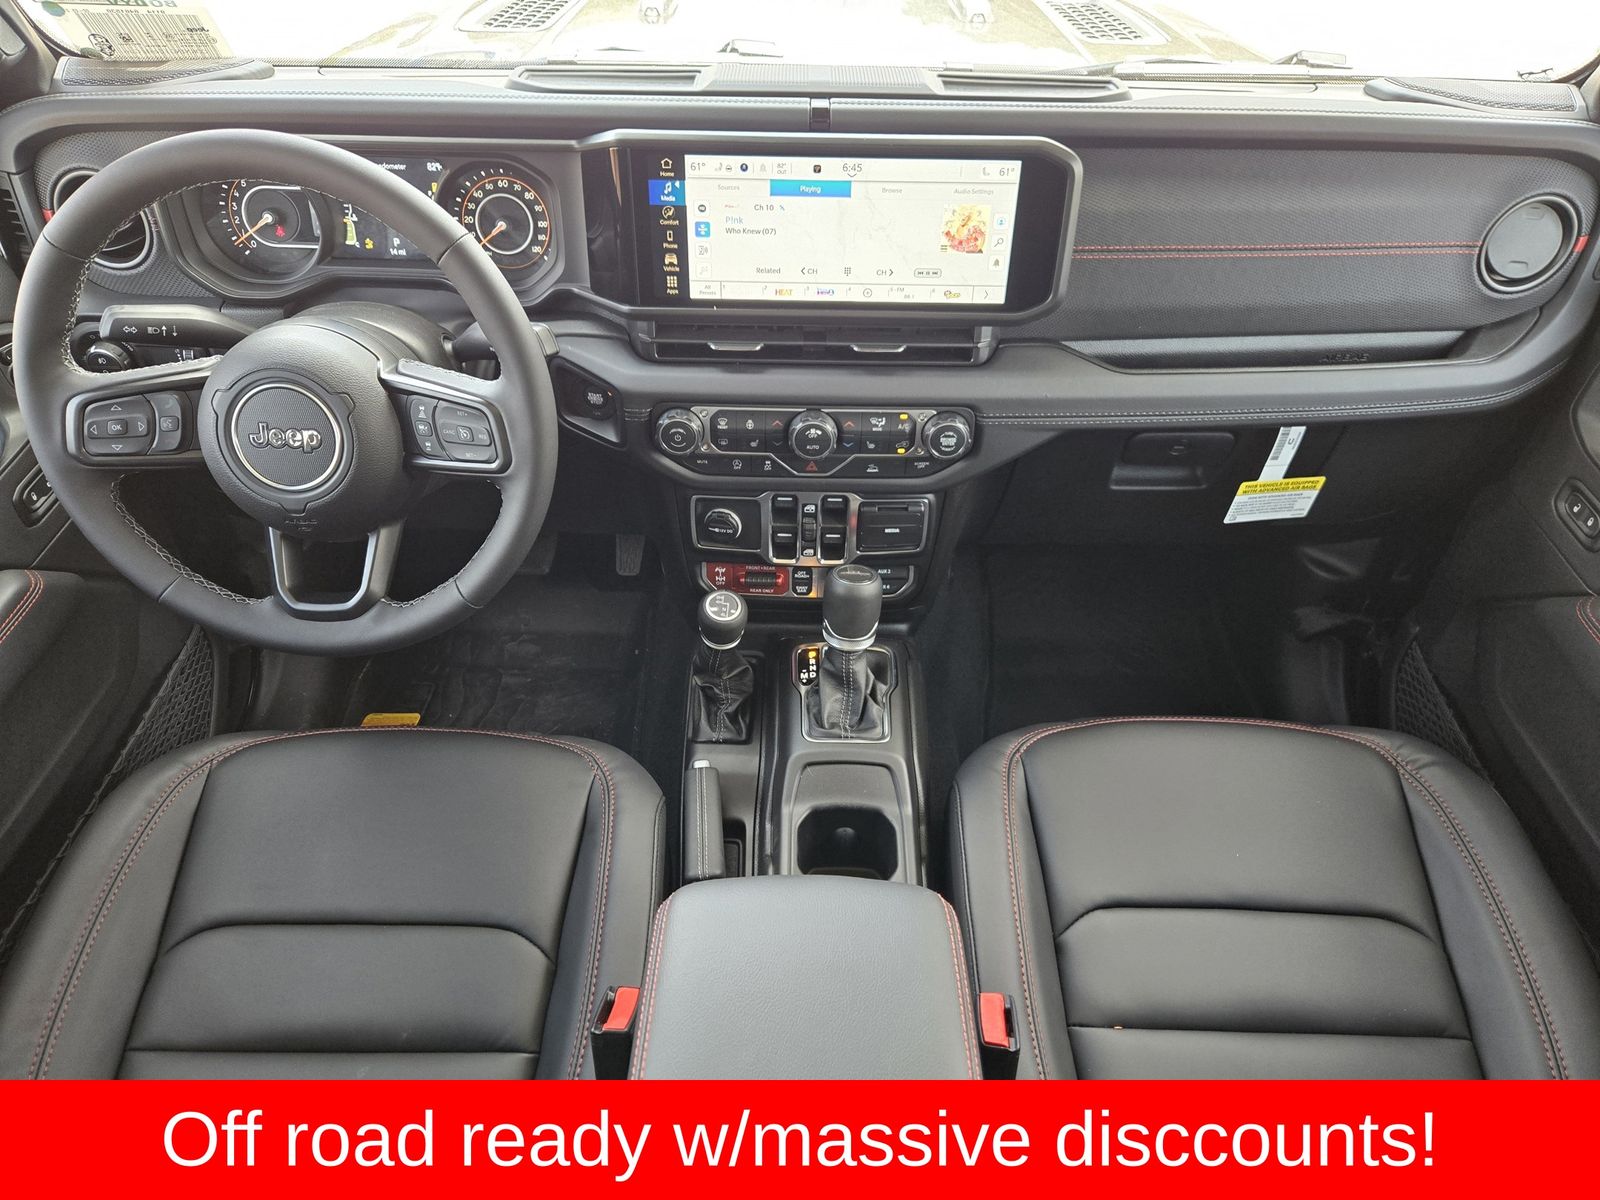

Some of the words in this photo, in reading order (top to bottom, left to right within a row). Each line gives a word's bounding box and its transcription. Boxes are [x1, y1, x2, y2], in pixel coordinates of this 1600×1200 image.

[842, 163, 863, 172] 6:45
[800, 185, 822, 194] Playing
[232, 202, 237, 210] 3
[393, 238, 400, 247] P
[249, 422, 322, 454] Jeep
